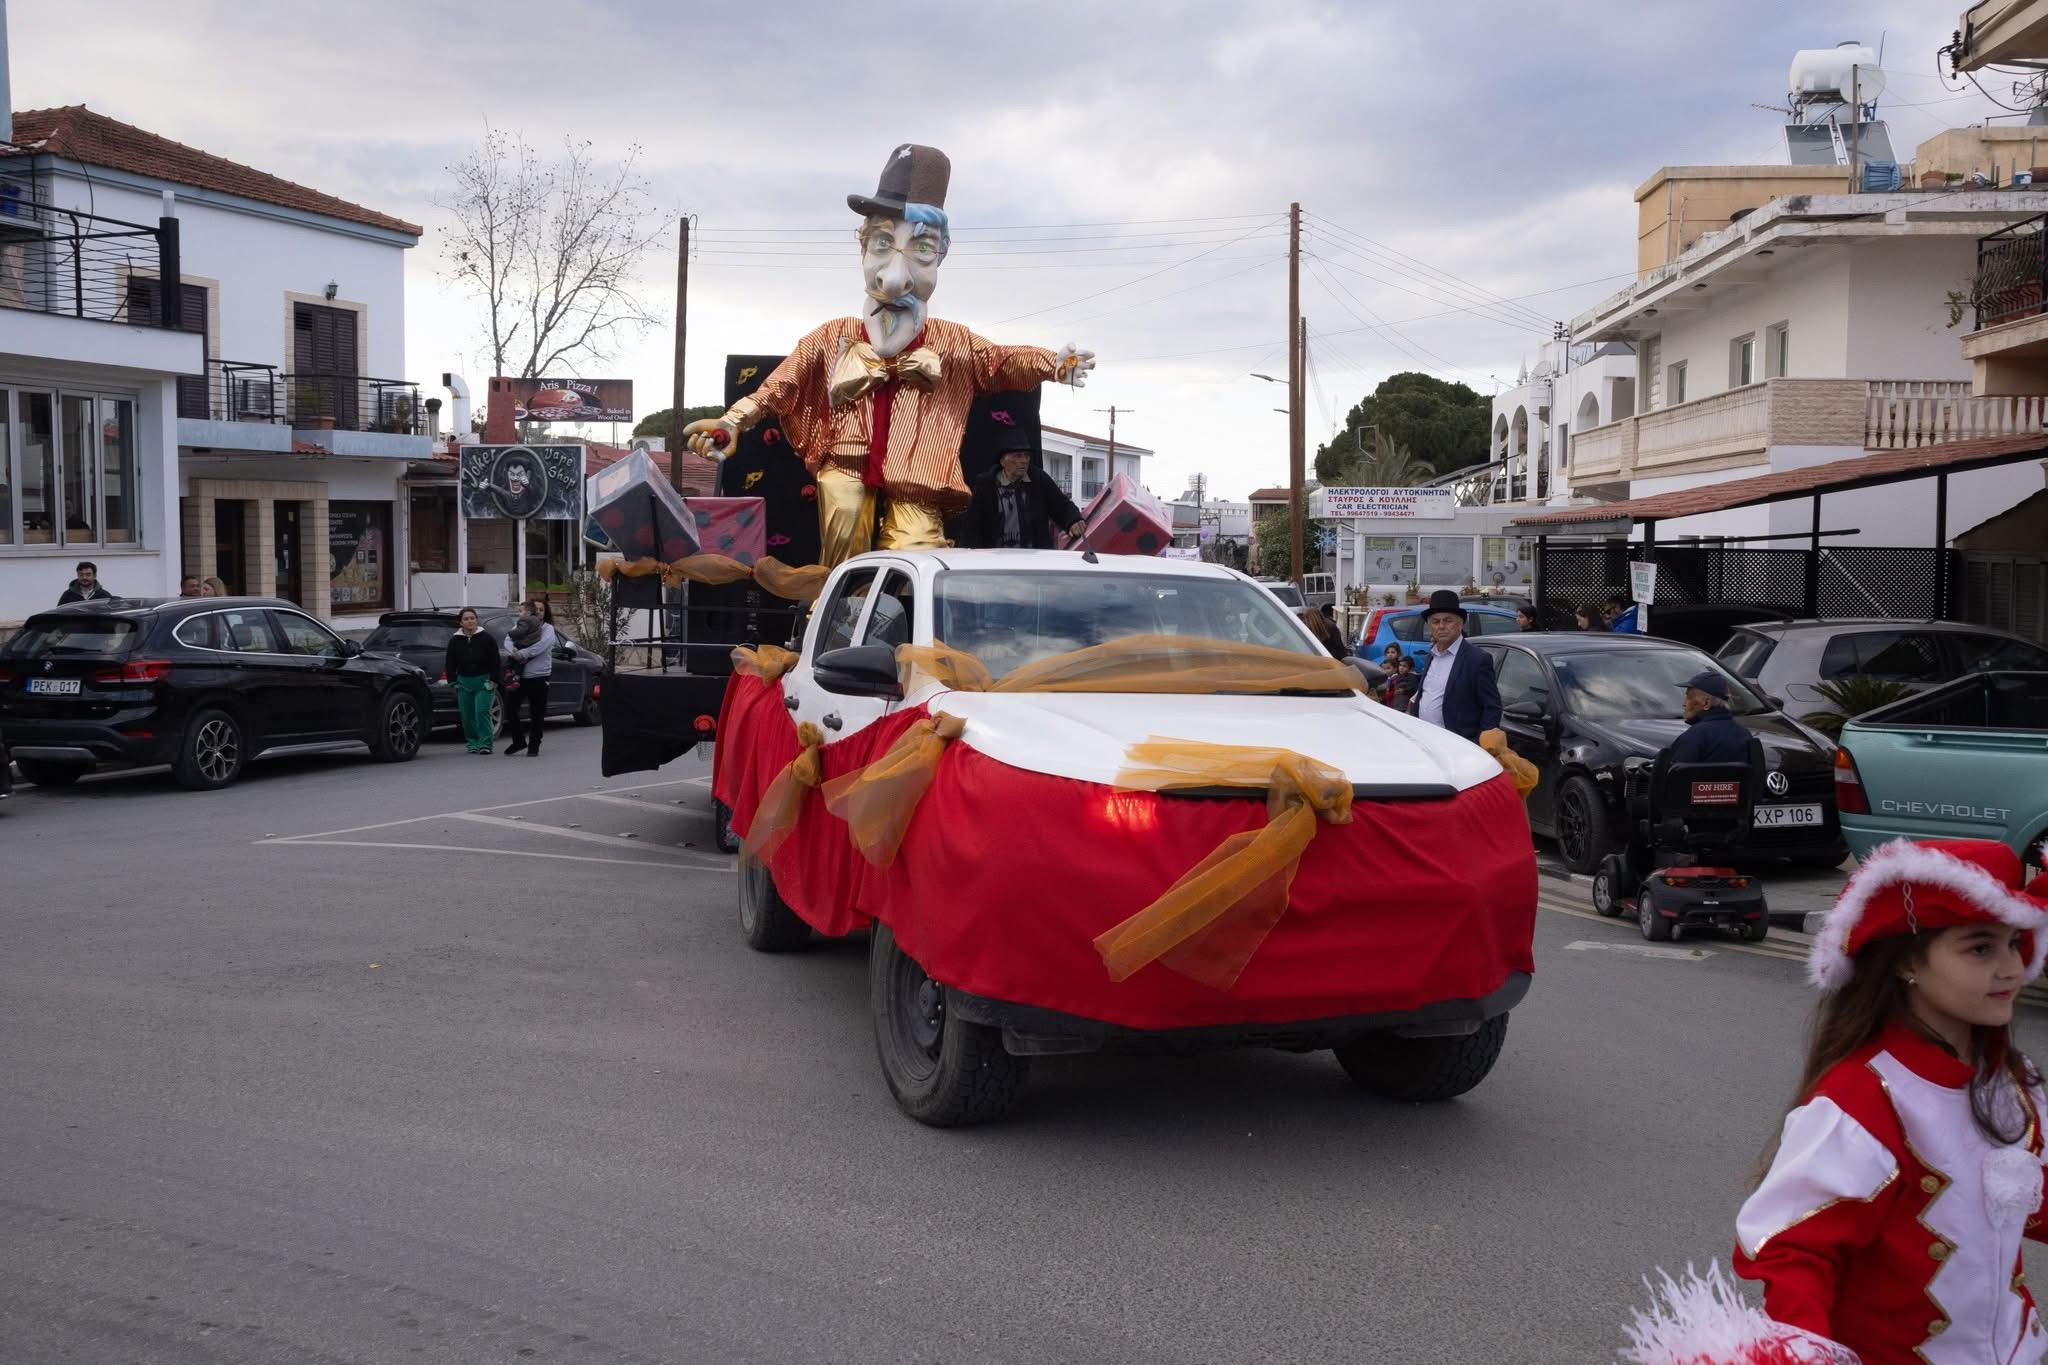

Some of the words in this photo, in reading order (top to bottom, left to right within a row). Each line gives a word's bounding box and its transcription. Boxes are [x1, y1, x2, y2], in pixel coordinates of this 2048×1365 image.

[540, 382, 560, 391] Aris
[544, 448, 573, 466] Vape
[461, 449, 496, 488] Joker
[548, 466, 576, 489] Shop
[1328, 488, 1389, 496] ΗΛΕΚΤΡΟΛΟΓΟΙ
[33, 681, 52, 691] PEK
[60, 681, 79, 692] 017
[1713, 783, 1734, 791] HIRE
[1753, 809, 1784, 824] KXP
[1789, 808, 1813, 823] 106
[1881, 799, 2011, 820] CHEVROLET
